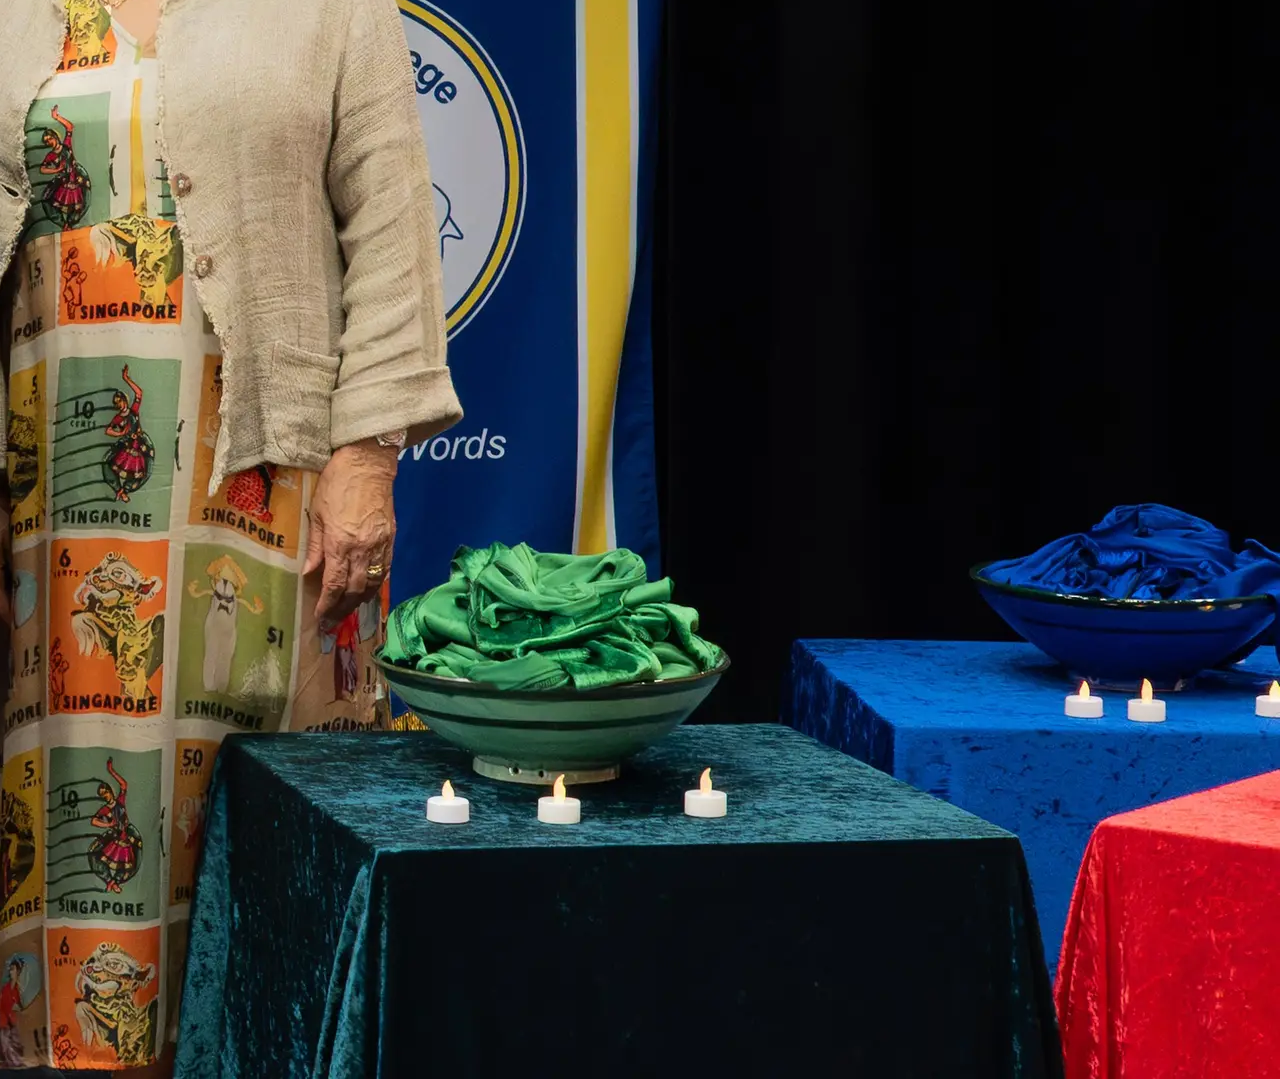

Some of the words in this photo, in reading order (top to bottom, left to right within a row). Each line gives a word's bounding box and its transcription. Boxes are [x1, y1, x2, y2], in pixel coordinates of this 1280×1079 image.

[80, 302, 178, 319] SINGAPORE
[73, 400, 95, 419] 10
[62, 508, 152, 528] SINGAPORE
[202, 507, 285, 548] SINGAPORE
[59, 548, 72, 567] 6
[63, 693, 158, 713] SINGAPORE
[183, 748, 203, 768] 50
[24, 760, 35, 780] 5
[58, 897, 145, 917] SINGAPORE
[59, 935, 70, 955] 6
